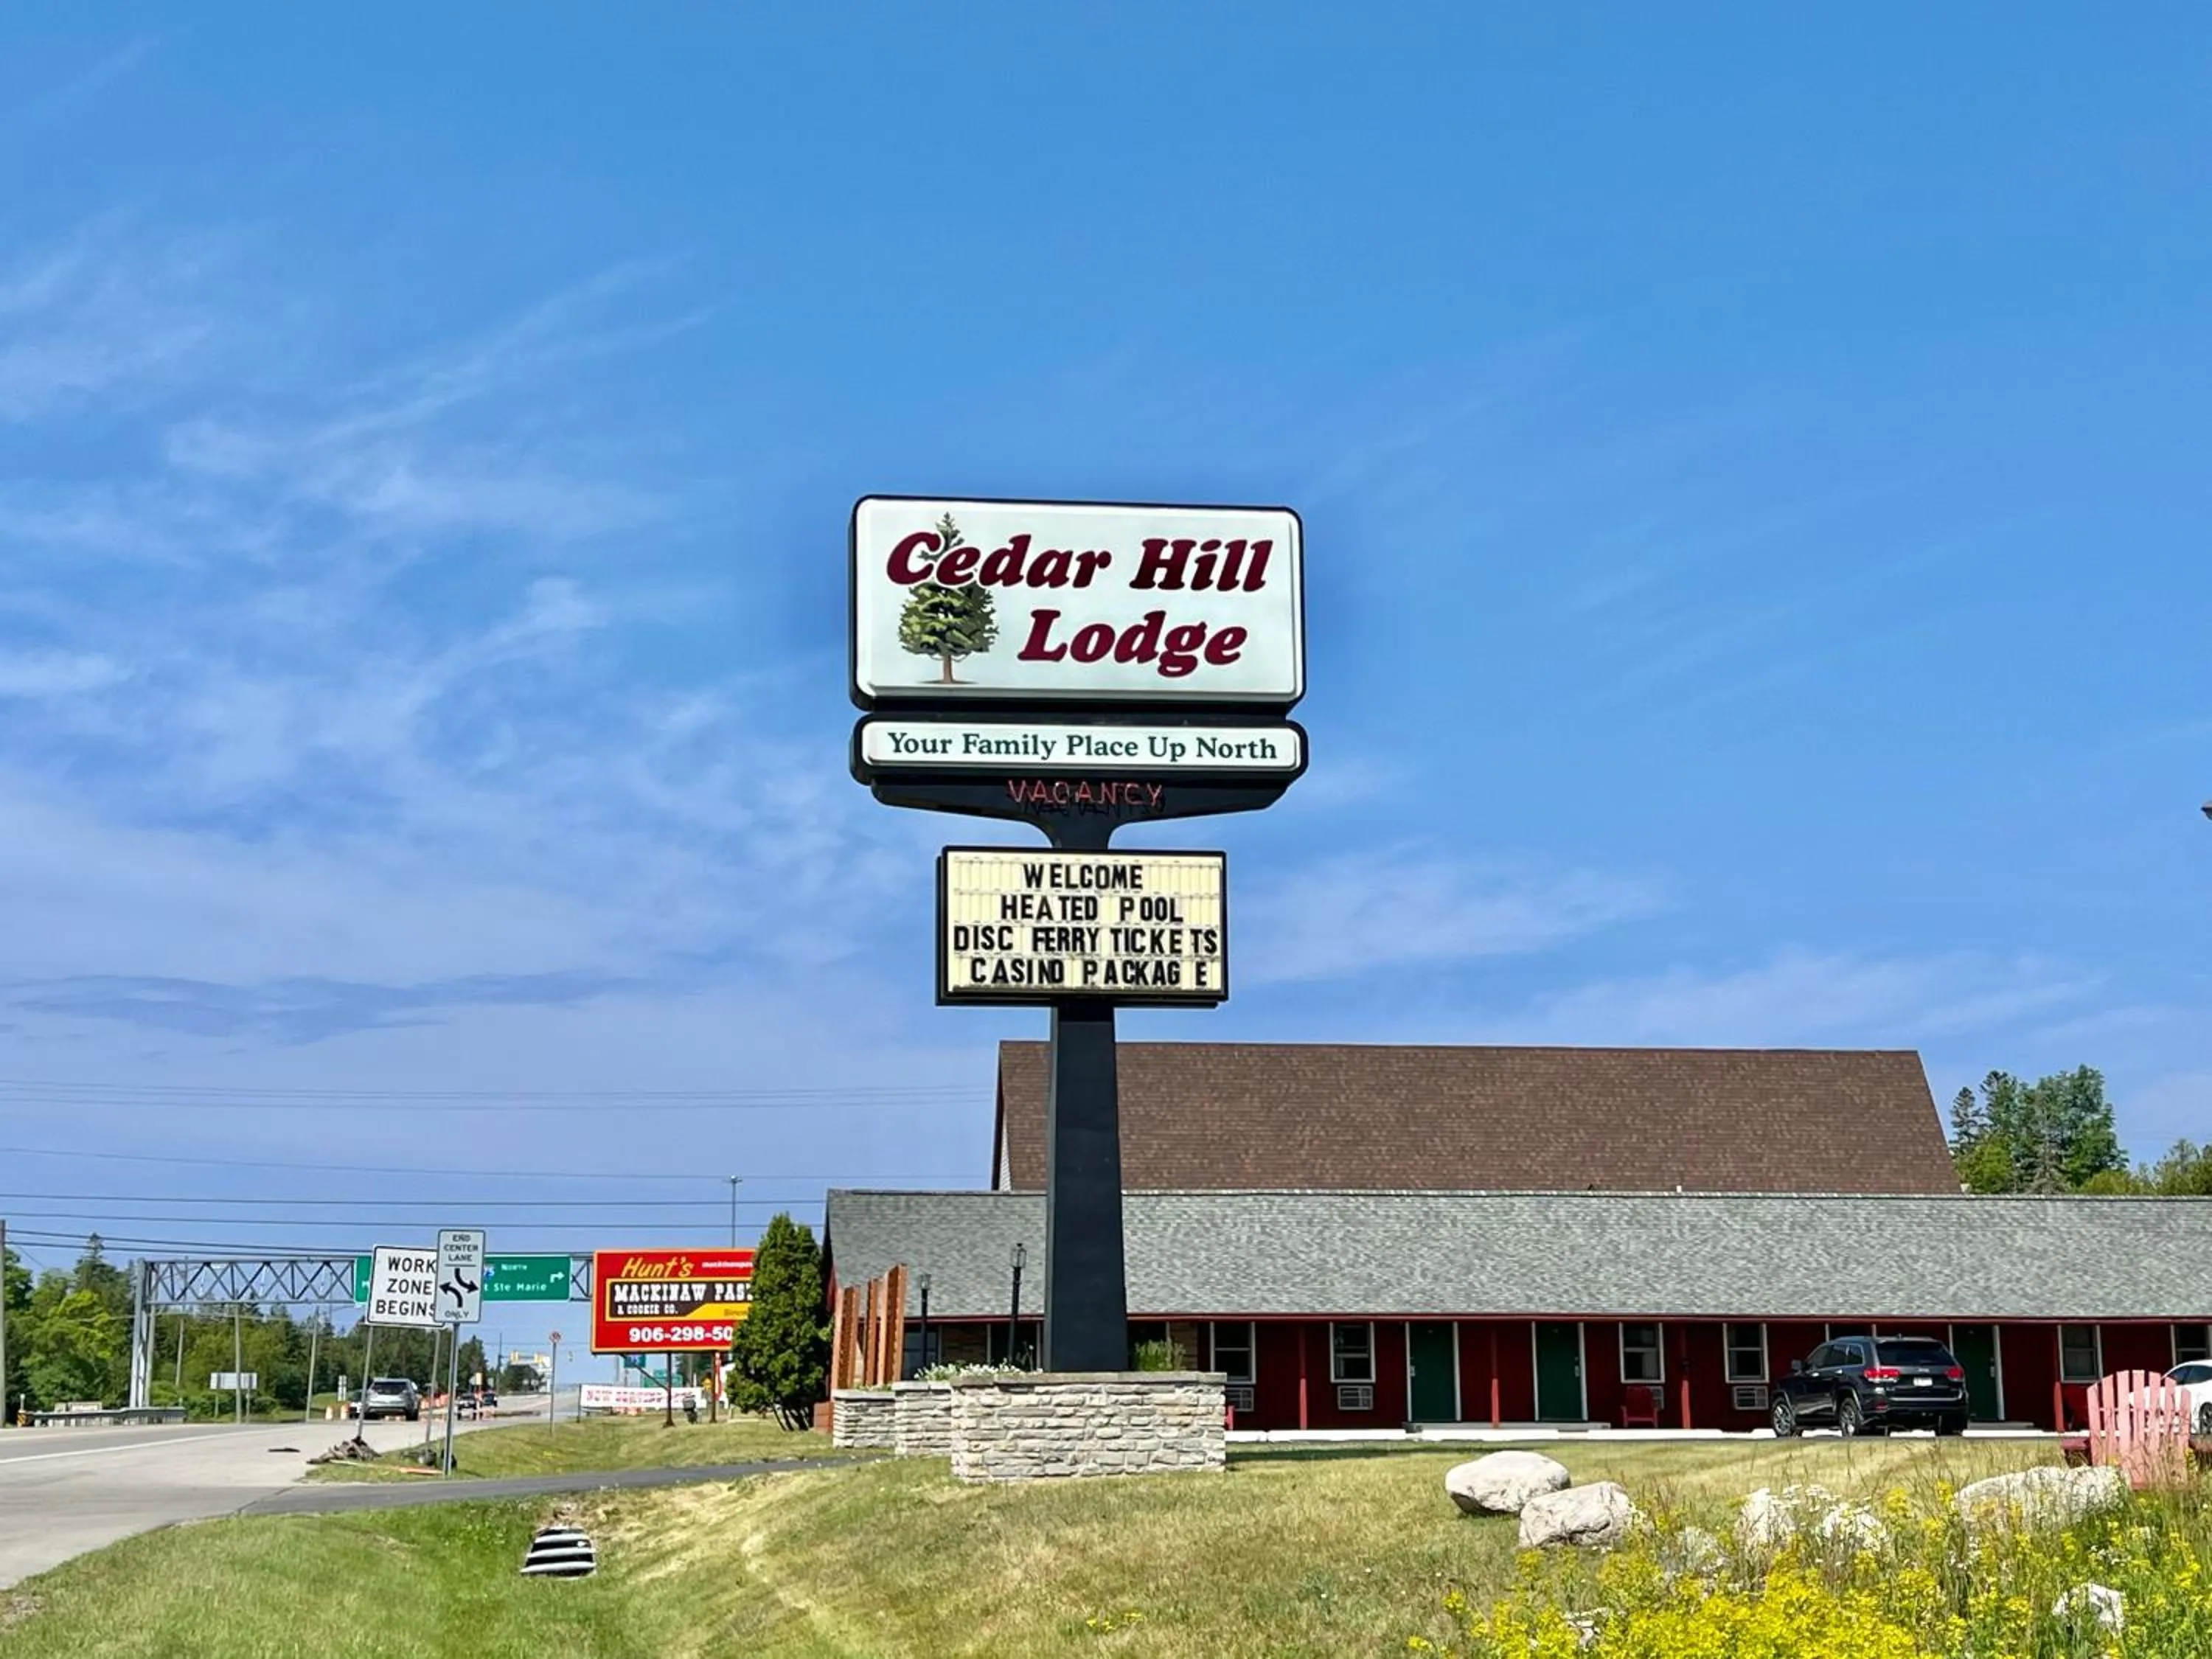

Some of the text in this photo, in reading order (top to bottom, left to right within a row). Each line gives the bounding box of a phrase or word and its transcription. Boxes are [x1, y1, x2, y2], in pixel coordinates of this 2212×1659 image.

[886, 532, 1274, 591] Cedar Hill
[1017, 609, 1248, 678] Lodge
[888, 732, 1278, 762] Your Family Place Up North
[1007, 779, 1163, 806] VACANCY
[1023, 863, 1144, 889] WELCOME
[1001, 894, 1183, 922] HEATED POOL
[953, 925, 1218, 955] DISC FERRY TICKETS
[970, 958, 1208, 987] CASINO PACKAGE
[443, 1243, 479, 1252] CENTER
[452, 1234, 471, 1242] END
[388, 1256, 437, 1275] WORK
[448, 1253, 473, 1262] LANE
[621, 1256, 695, 1278] Hunt's
[386, 1278, 434, 1296] ZONE
[516, 1282, 548, 1292] Marie
[614, 1283, 706, 1302] MACKINAW
[375, 1298, 437, 1318] BEGINS
